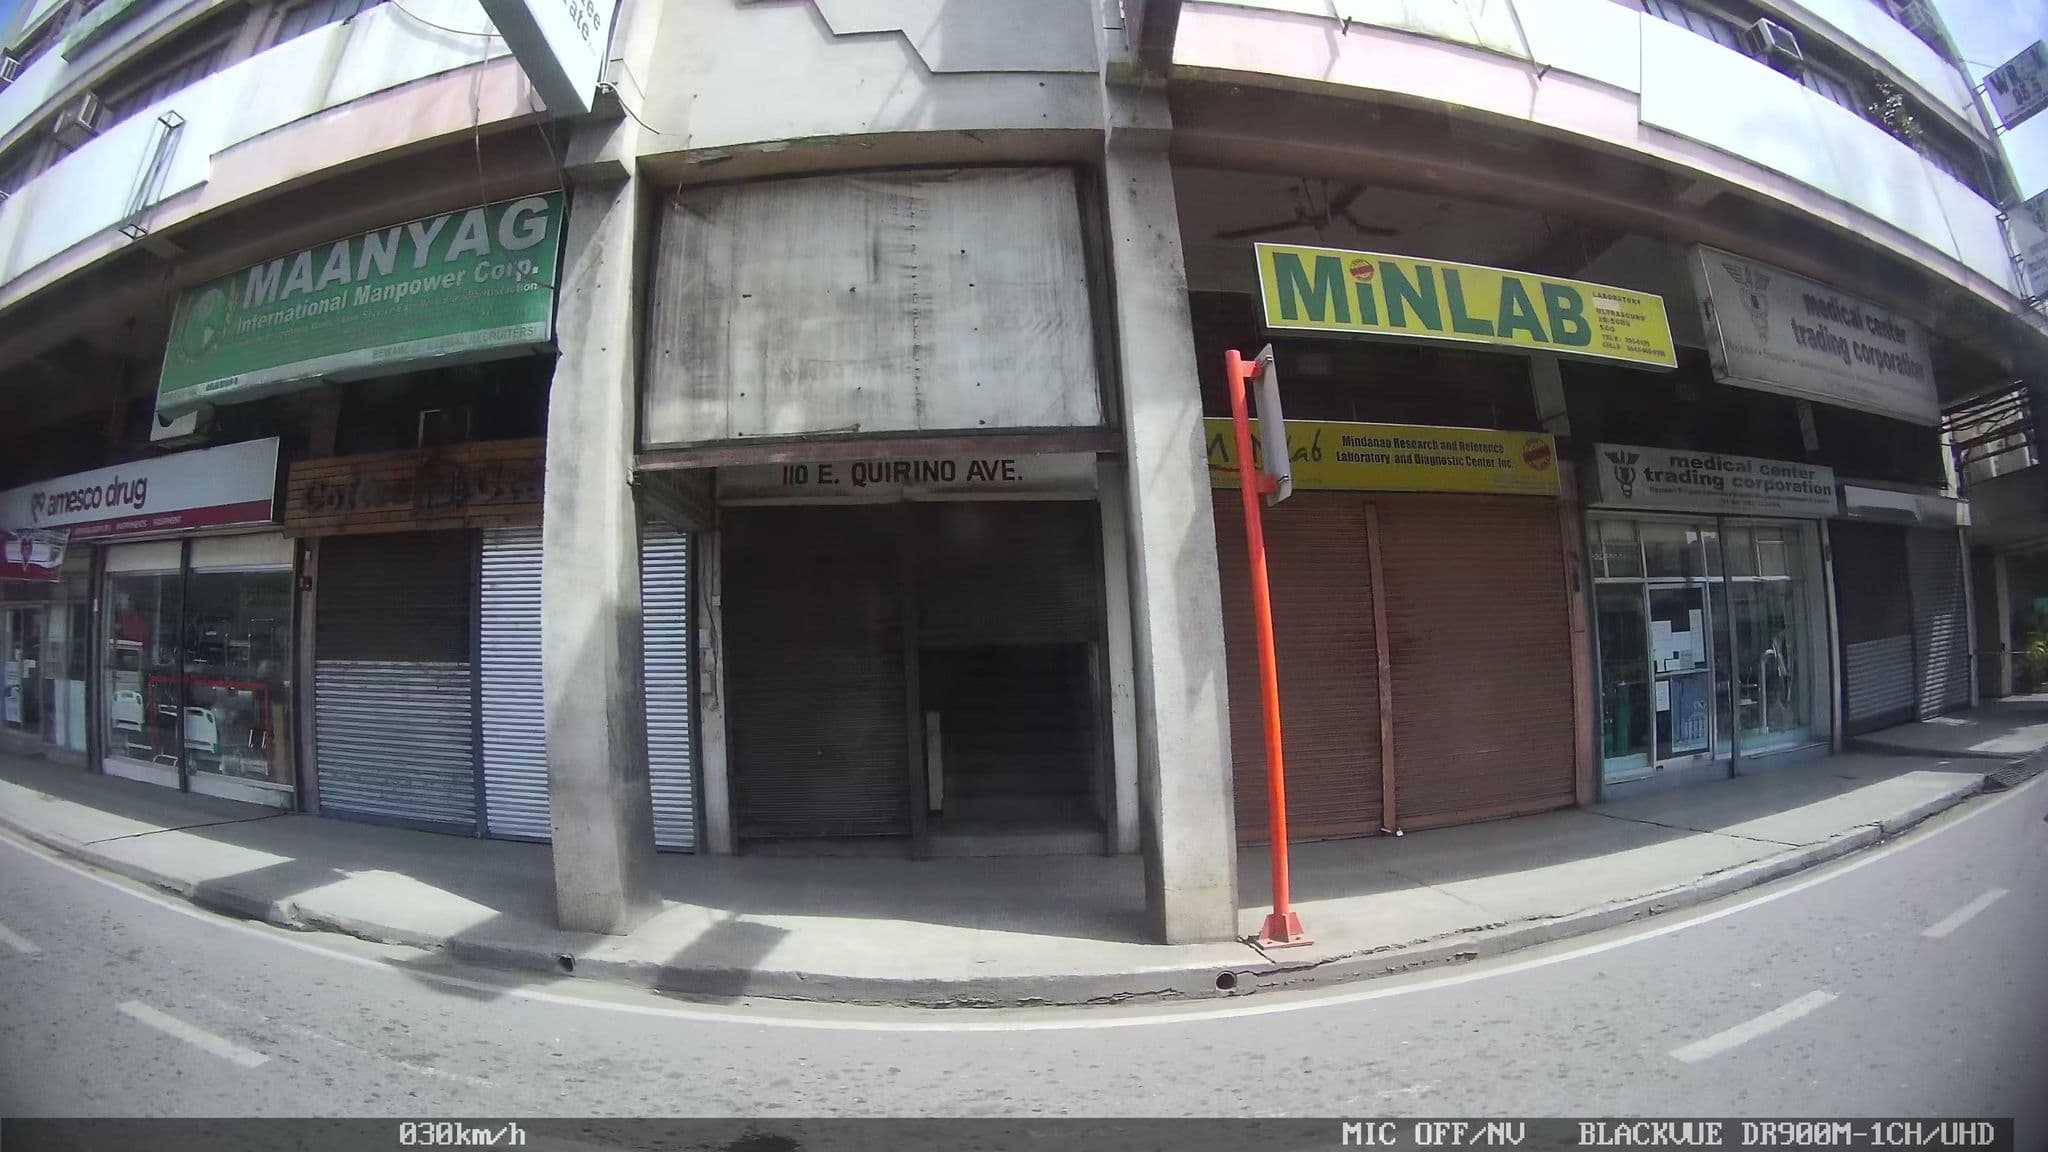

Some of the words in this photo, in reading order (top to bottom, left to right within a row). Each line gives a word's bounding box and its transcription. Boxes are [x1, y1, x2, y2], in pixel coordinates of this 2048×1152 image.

[243, 197, 549, 310] MAANYAG
[237, 290, 349, 334] International
[353, 269, 465, 307] Manpower
[474, 258, 540, 284] Corp.
[1803, 292, 1864, 330] medical
[1866, 314, 1907, 345] center
[1791, 317, 1852, 365] trading
[1853, 341, 1928, 380] corporation
[1342, 435, 1392, 449] Mindanao
[1394, 439, 1439, 450] Research
[1440, 440, 1458, 451] and
[1395, 453, 1413, 465] and
[1414, 454, 1465, 468] Diagnostic
[818, 463, 840, 485] E.
[850, 459, 956, 488] QUIRINO
[966, 458, 1023, 482] AVE.
[1643, 466, 1725, 490] trading
[1731, 476, 1832, 496] corporation
[1669, 453, 1752, 473] medical
[1760, 463, 1816, 480] center
[47, 487, 102, 517] amesco
[105, 475, 149, 509] drug
